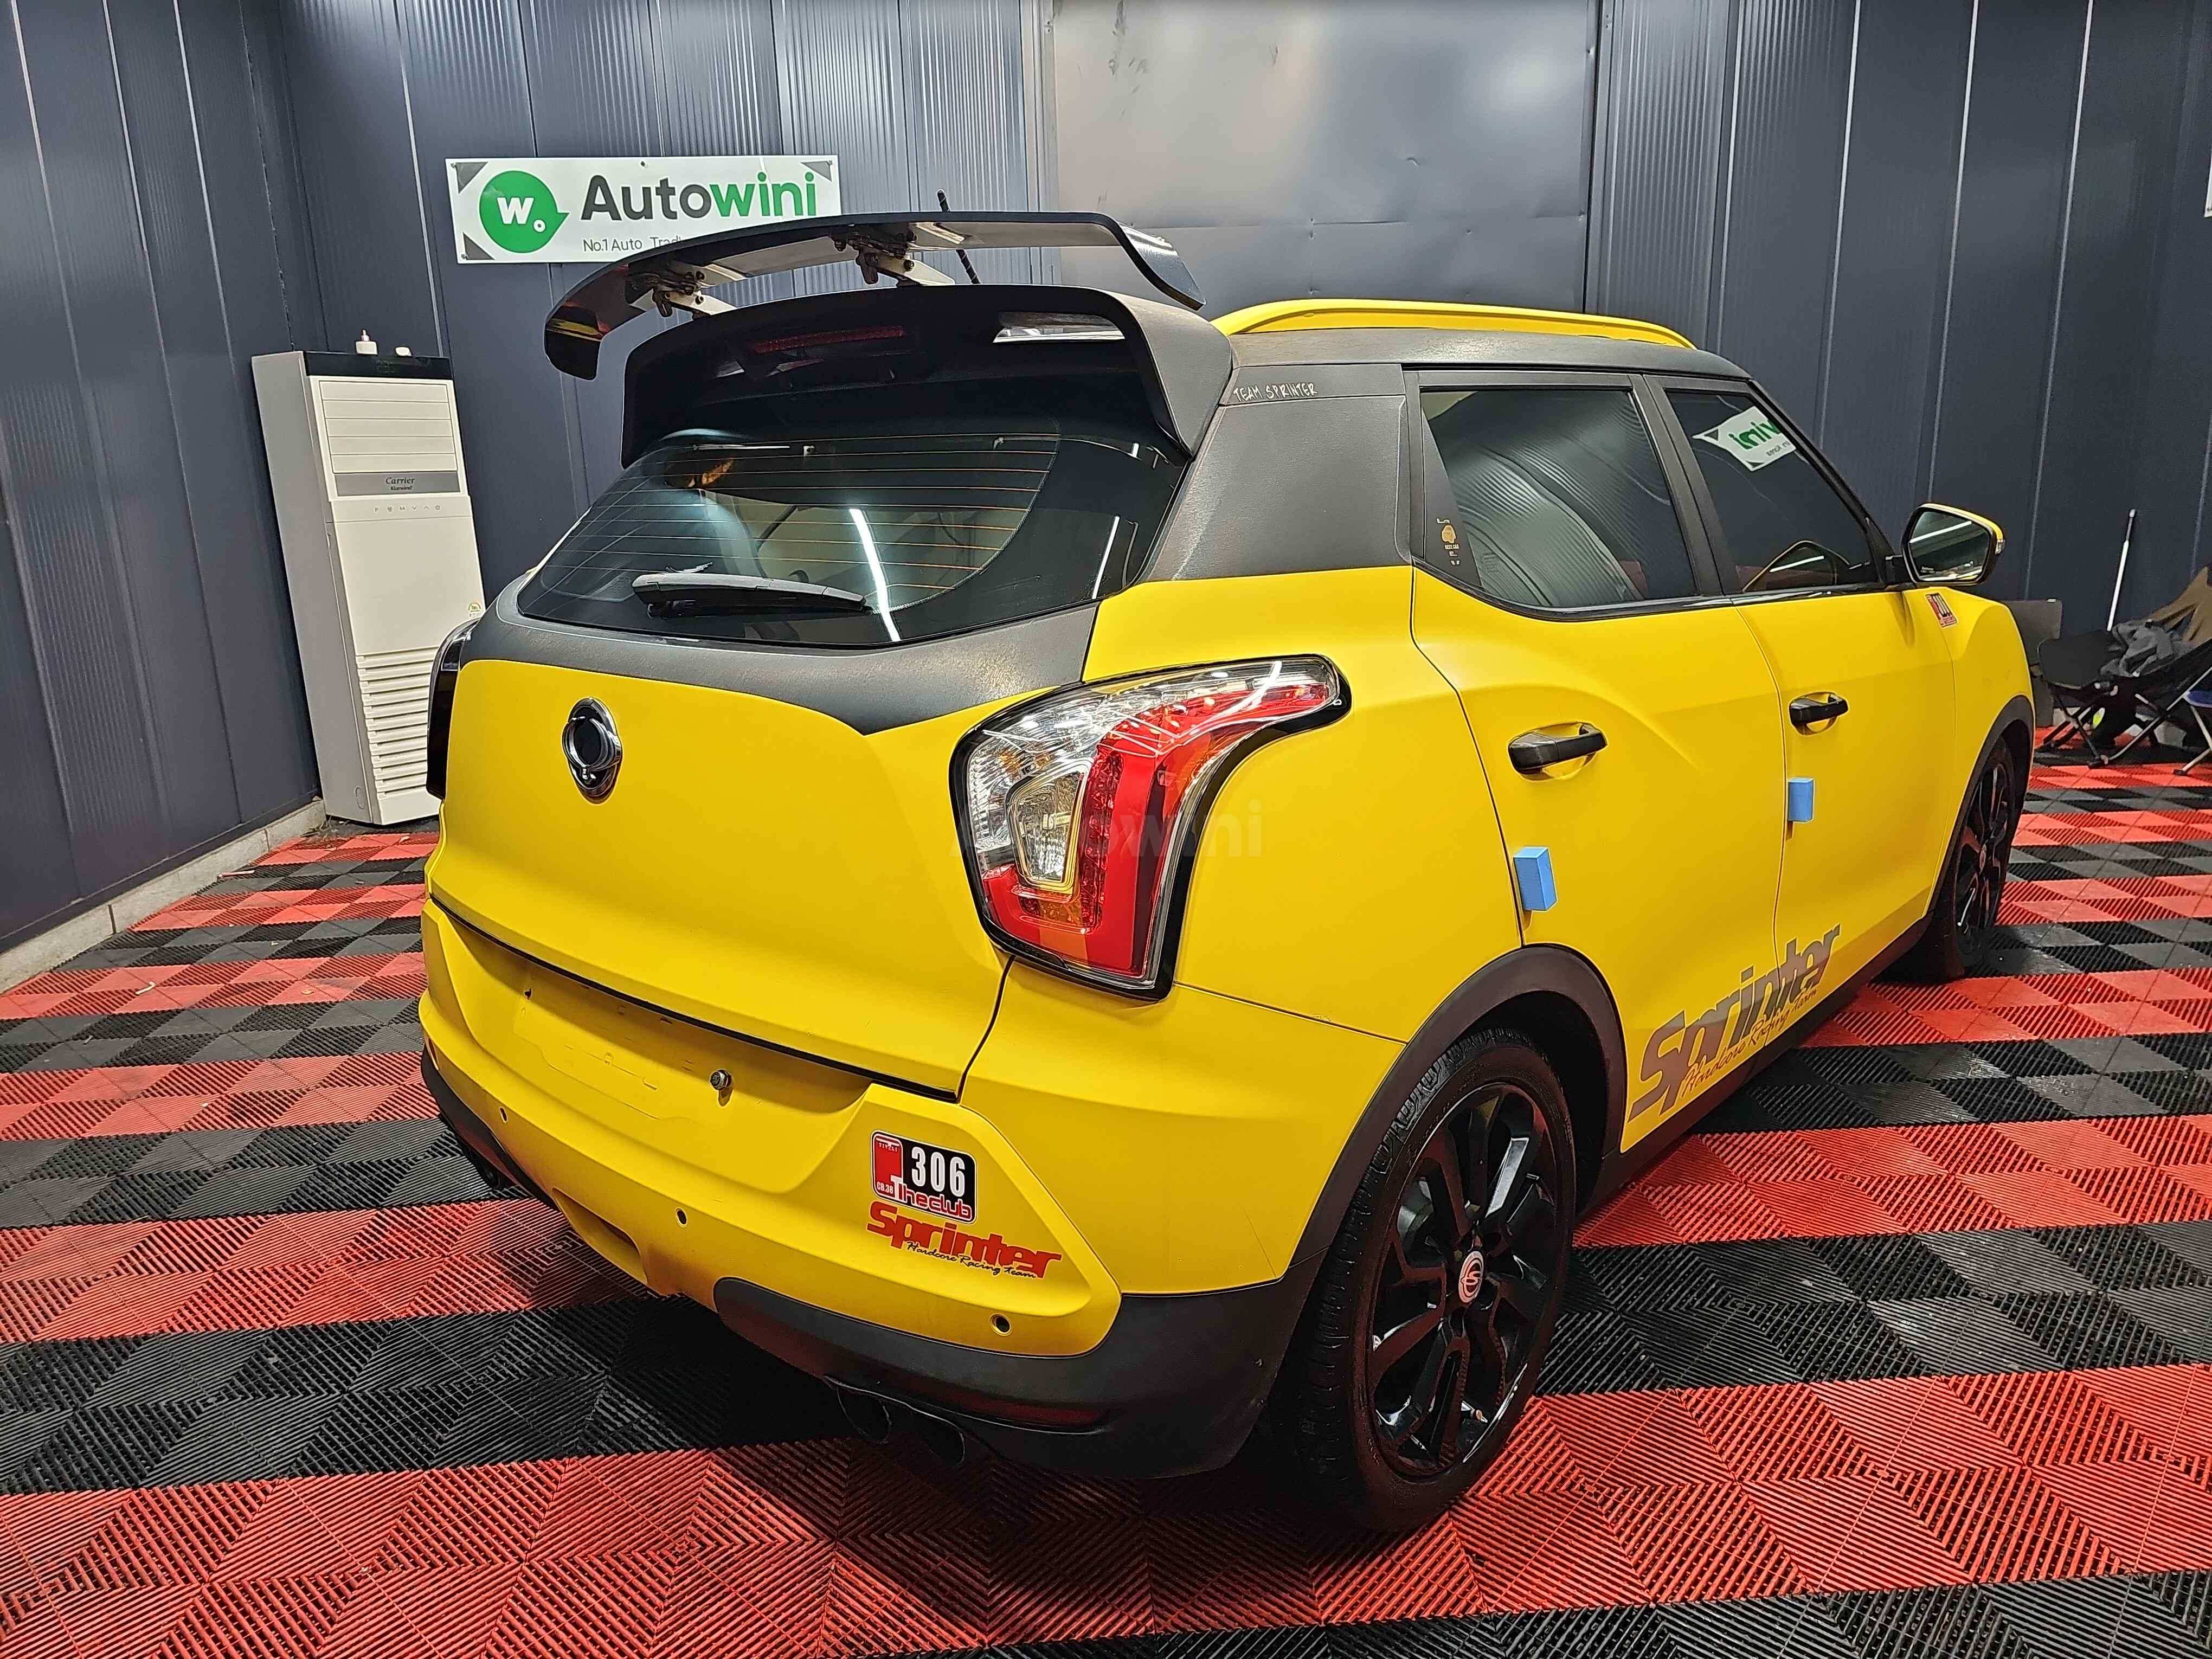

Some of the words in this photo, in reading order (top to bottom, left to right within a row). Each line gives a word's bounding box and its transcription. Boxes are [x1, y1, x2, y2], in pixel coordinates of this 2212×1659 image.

[581, 171, 816, 221] Autowini
[583, 238, 608, 252] No.1
[611, 238, 642, 251] Auto
[1233, 384, 1263, 402] TEAM
[1265, 382, 1318, 399] SPRINTER
[385, 477, 416, 485] Carrier
[1627, 923, 1841, 1124] Sprinter
[878, 1142, 898, 1153] TIVOLI
[911, 1146, 966, 1197] 306
[876, 1181, 893, 1194] CB.38
[867, 1200, 1063, 1279] Sprinter
[906, 1241, 957, 1262] Hardcore
[959, 1255, 1001, 1276] Racing
